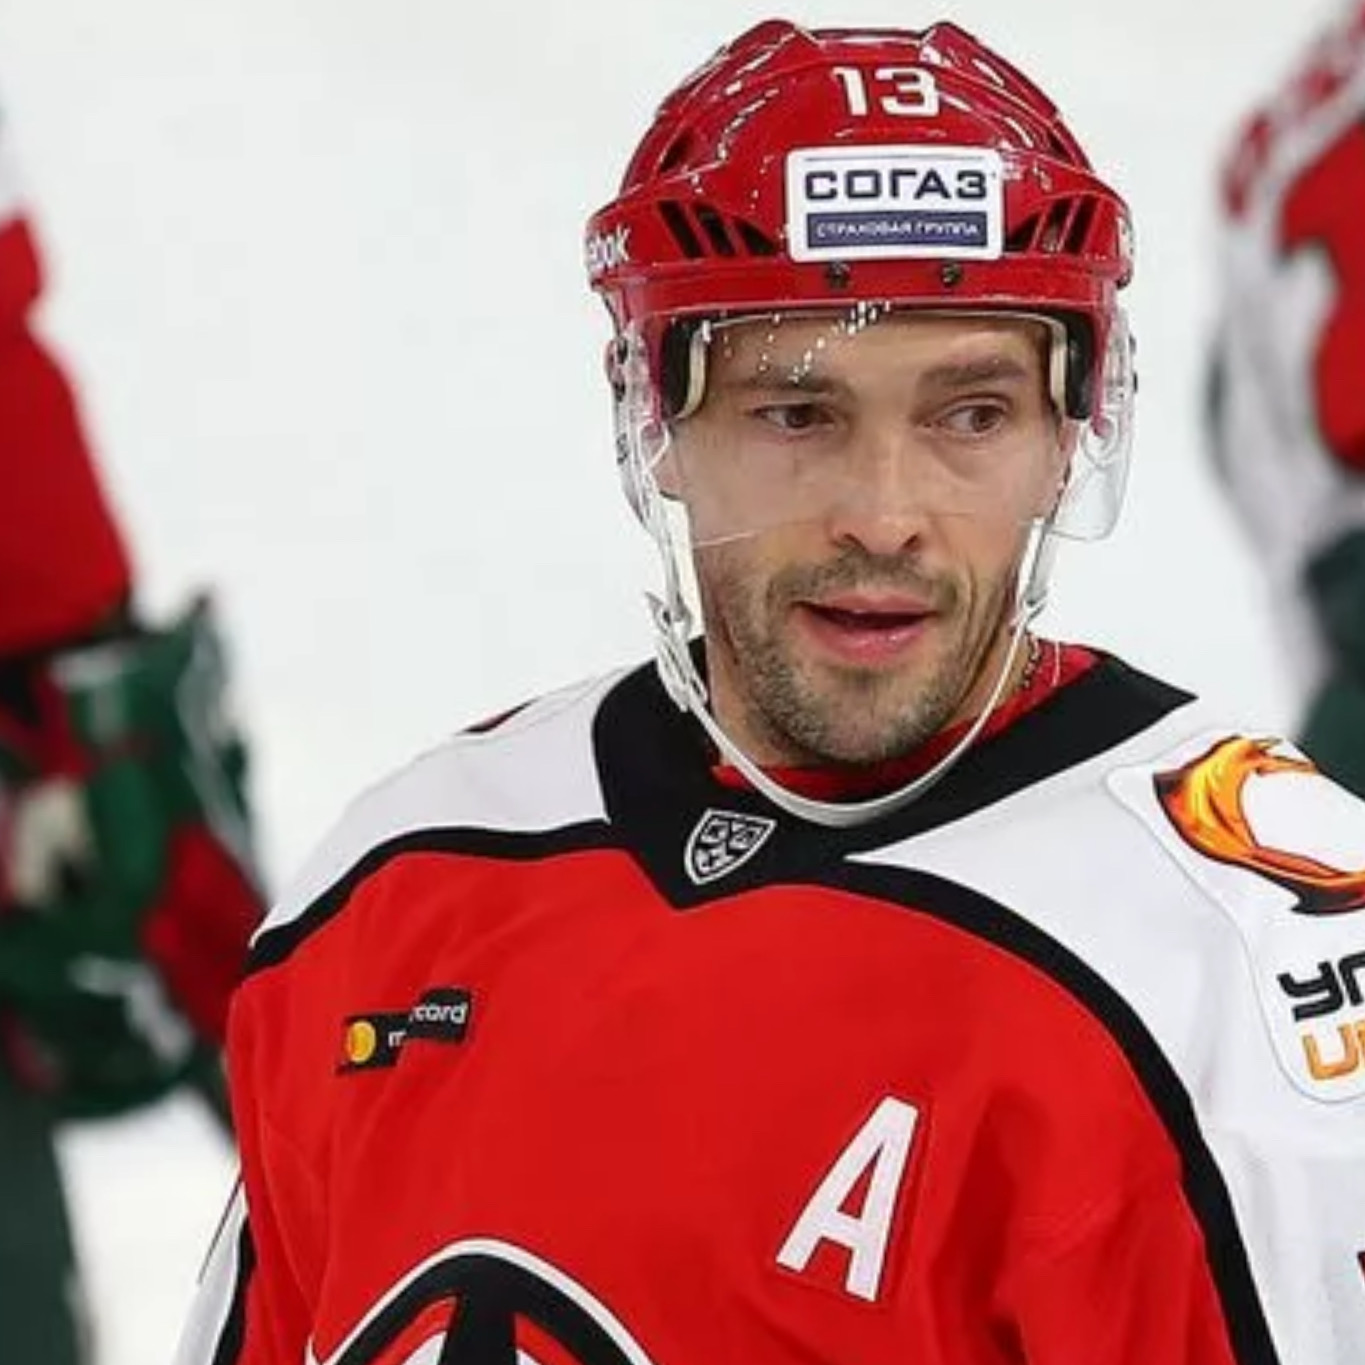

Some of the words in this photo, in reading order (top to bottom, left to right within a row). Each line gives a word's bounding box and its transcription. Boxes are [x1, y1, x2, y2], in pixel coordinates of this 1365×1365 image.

[830, 66, 939, 117] 13
[806, 168, 986, 200] СОГАЗ
[816, 221, 912, 239] СТРАХОВАЯ
[916, 221, 980, 236] ГРУППА
[777, 1096, 919, 1302] A
